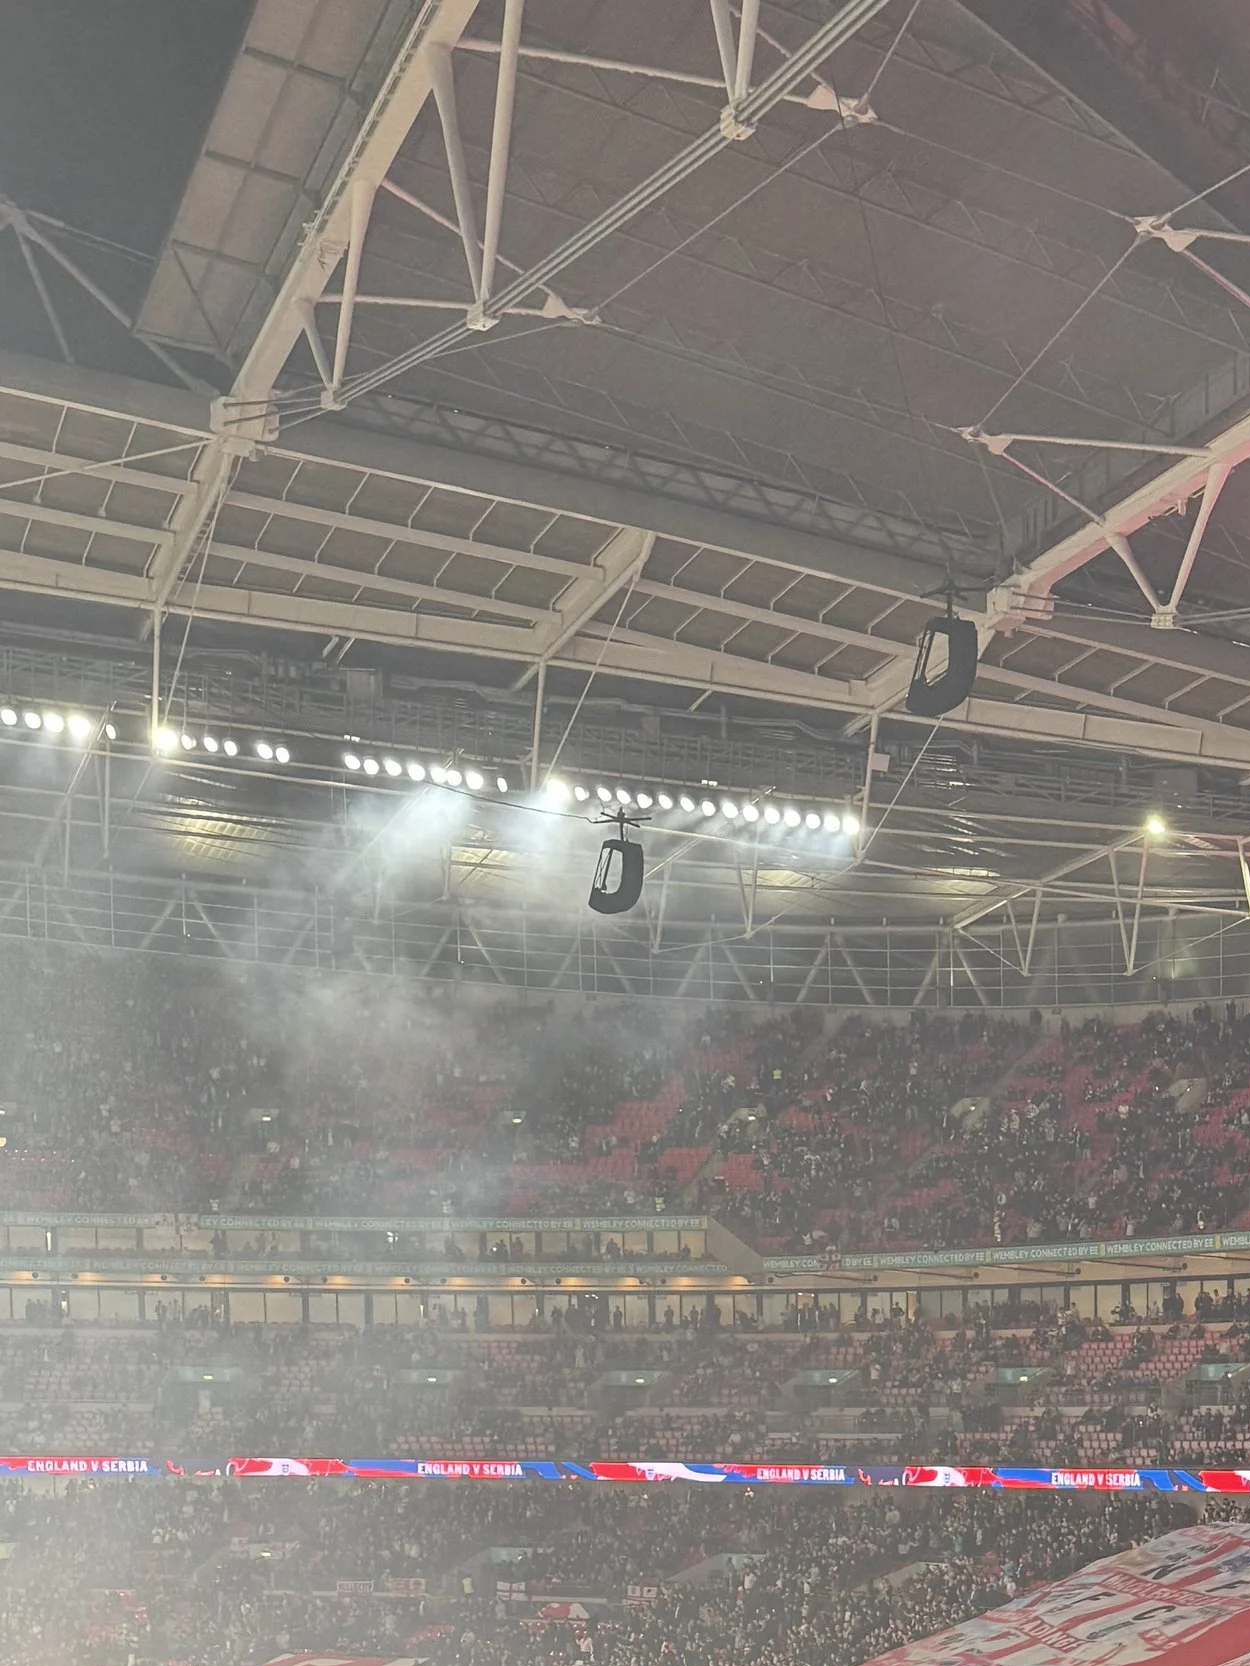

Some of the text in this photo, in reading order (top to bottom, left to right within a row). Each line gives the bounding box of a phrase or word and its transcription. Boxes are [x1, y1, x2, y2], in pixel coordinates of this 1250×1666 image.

[583, 1219, 625, 1230] WEMBLEY
[626, 1219, 678, 1229] CONNECTED
[992, 1246, 1098, 1260] WEMBLEY CONNECTED BY EE
[1107, 1238, 1213, 1254] WEMBLEY CONNECTED BY EE
[763, 1259, 800, 1270] WEMBLEY
[880, 1252, 985, 1266] WEMBLEY CONNECTED BY EE
[28, 1460, 149, 1472] ENGLAND V SERBIA
[418, 1463, 523, 1476] ENGLAND V SERBIA
[757, 1467, 845, 1481] ENGLAND V SERBIA
[1051, 1472, 1141, 1486] ENGLAND V SERBIA
